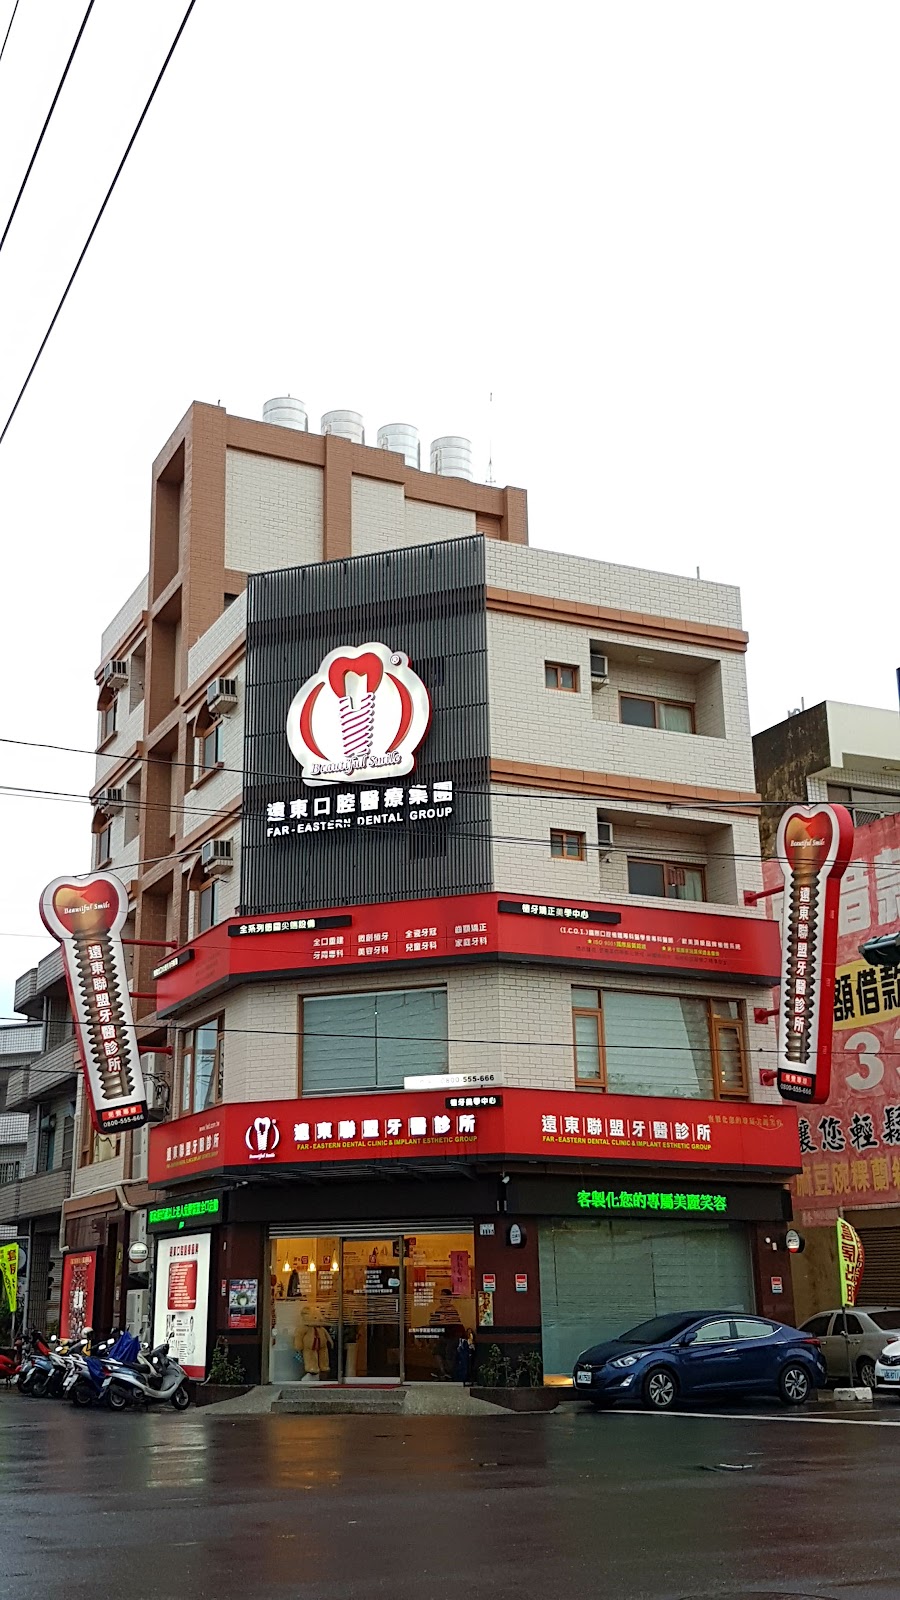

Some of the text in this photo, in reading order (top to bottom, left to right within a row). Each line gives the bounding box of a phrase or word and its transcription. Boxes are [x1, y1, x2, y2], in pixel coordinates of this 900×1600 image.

[311, 751, 402, 776] Beautiful Smile
[267, 781, 453, 822] 遠東口腔醫療集團
[357, 813, 403, 825] DENTAL
[410, 807, 453, 820] GROUP
[792, 886, 811, 1034] 遠東聯盟牙醫診所
[87, 945, 122, 1073] 遠東聯盟牙醫診所
[293, 1114, 476, 1142] 遠東聯盟牙醫診所
[541, 1114, 712, 1141] 遠東聯盟牙醫診所
[342, 1140, 366, 1148] DENTAL
[367, 1139, 388, 1147] CLINIC
[394, 1138, 421, 1146] IMPLANT
[422, 1136, 454, 1145] ESTHETIC
[455, 1135, 478, 1143] GROUP
[587, 1137, 610, 1145] DENTAL
[636, 1140, 661, 1148] IMPLANT
[577, 1190, 727, 1212] 客製化您的專屬美麗笑容
